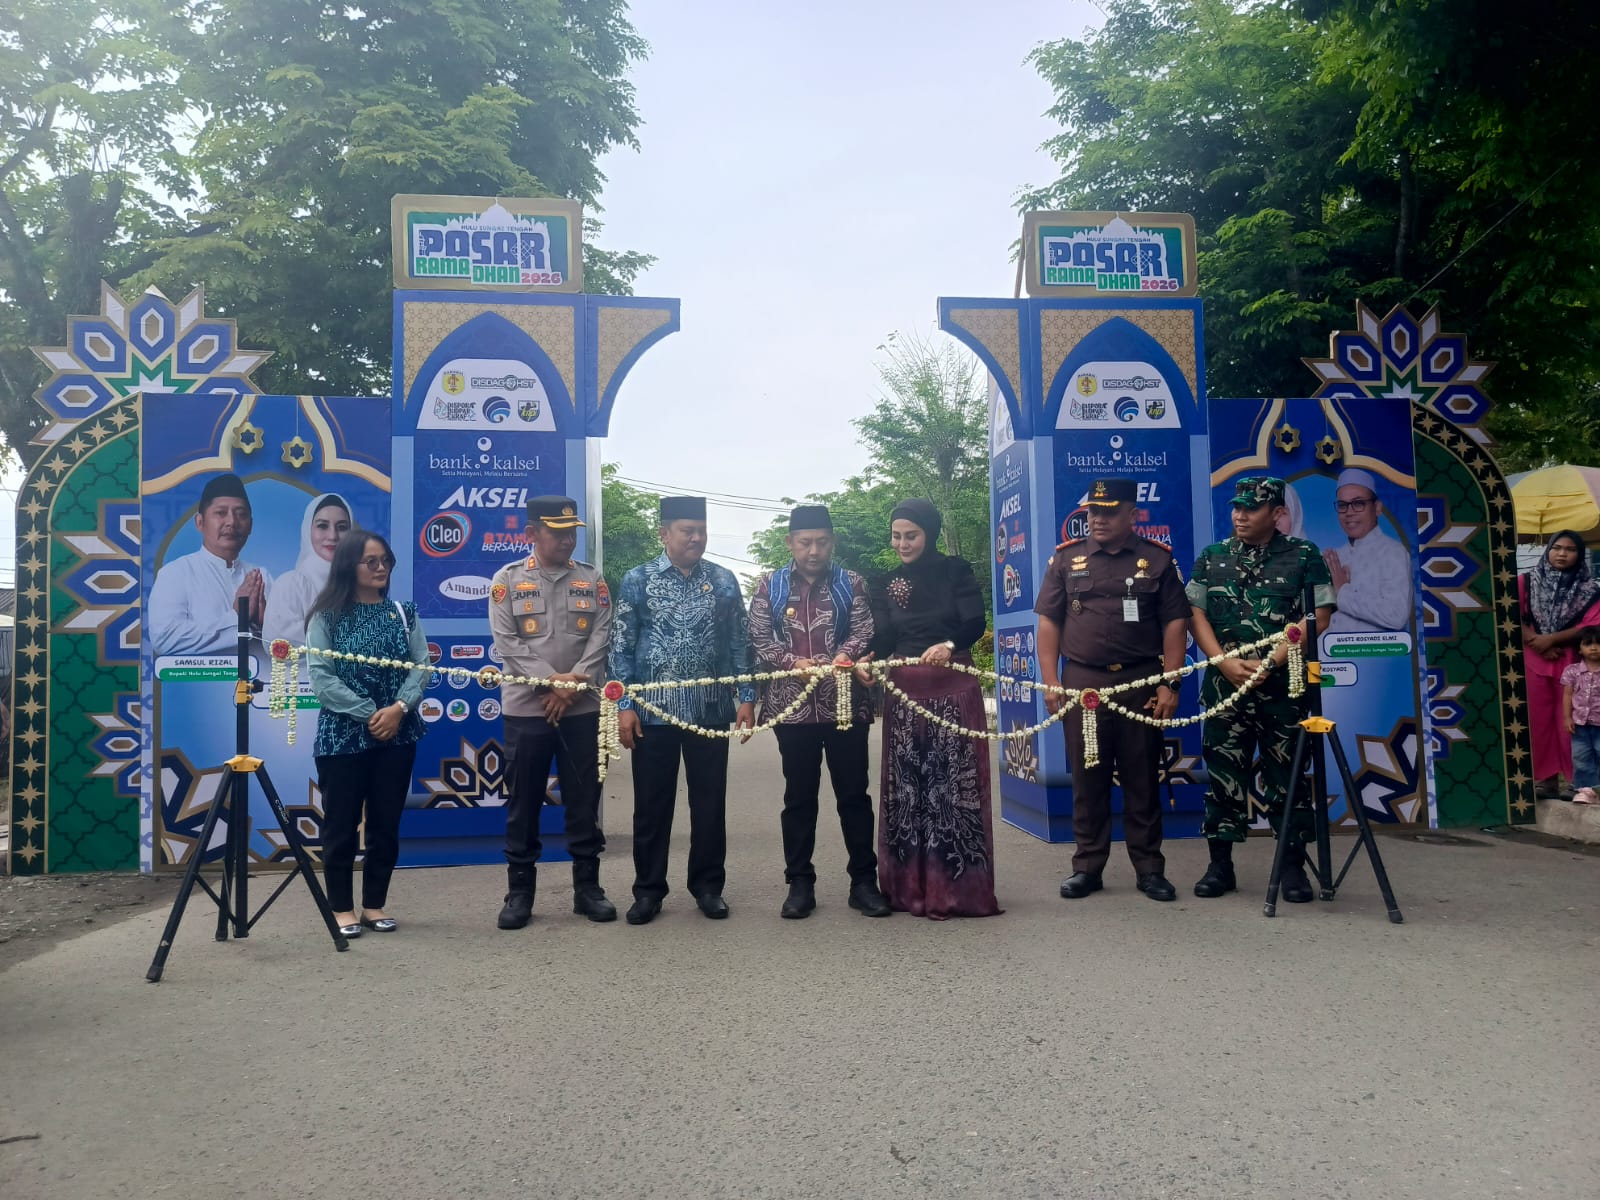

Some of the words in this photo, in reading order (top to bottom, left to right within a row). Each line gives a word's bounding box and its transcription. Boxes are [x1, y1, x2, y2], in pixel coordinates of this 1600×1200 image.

[521, 273, 561, 283] 2026
[1142, 279, 1177, 289] 2026
[518, 378, 536, 389] HST
[430, 454, 472, 469] bank
[494, 455, 540, 471] kalsel
[1067, 452, 1106, 466] bank
[1124, 452, 1168, 466] kalsel
[438, 485, 528, 509] AKSEL
[1000, 493, 1022, 522] AKSEL
[430, 524, 461, 543] Cleo
[1072, 519, 1090, 536] Cle
[514, 590, 540, 599] JUPRI
